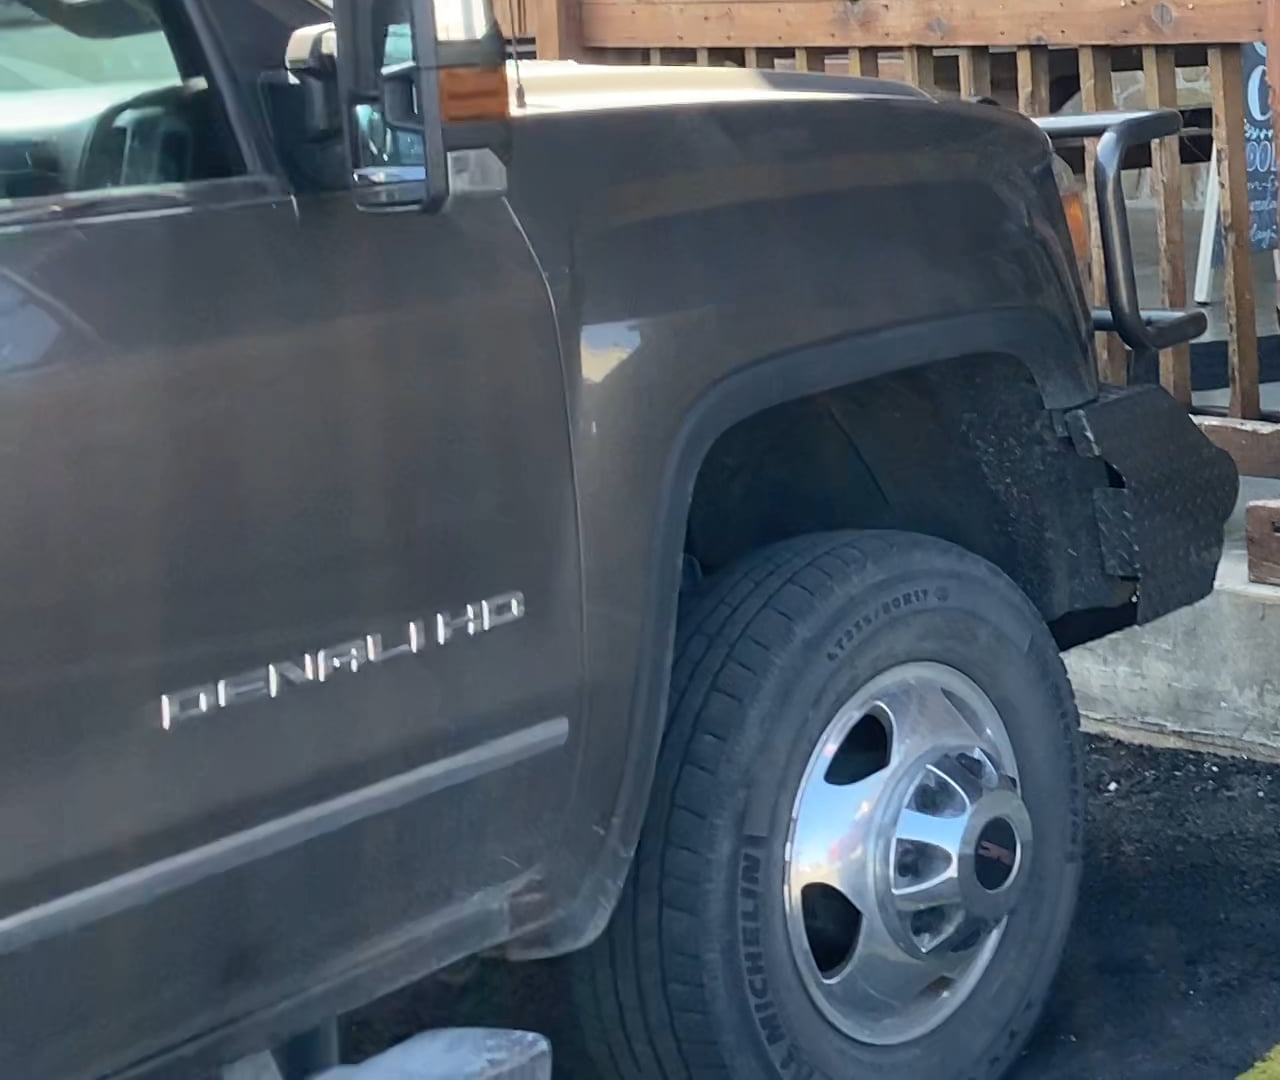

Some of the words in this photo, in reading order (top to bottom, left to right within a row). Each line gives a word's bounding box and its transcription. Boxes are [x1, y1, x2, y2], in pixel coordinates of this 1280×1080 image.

[160, 619, 426, 732] DENALI
[436, 589, 526, 646] HD
[740, 851, 787, 1047] MICHELIN
